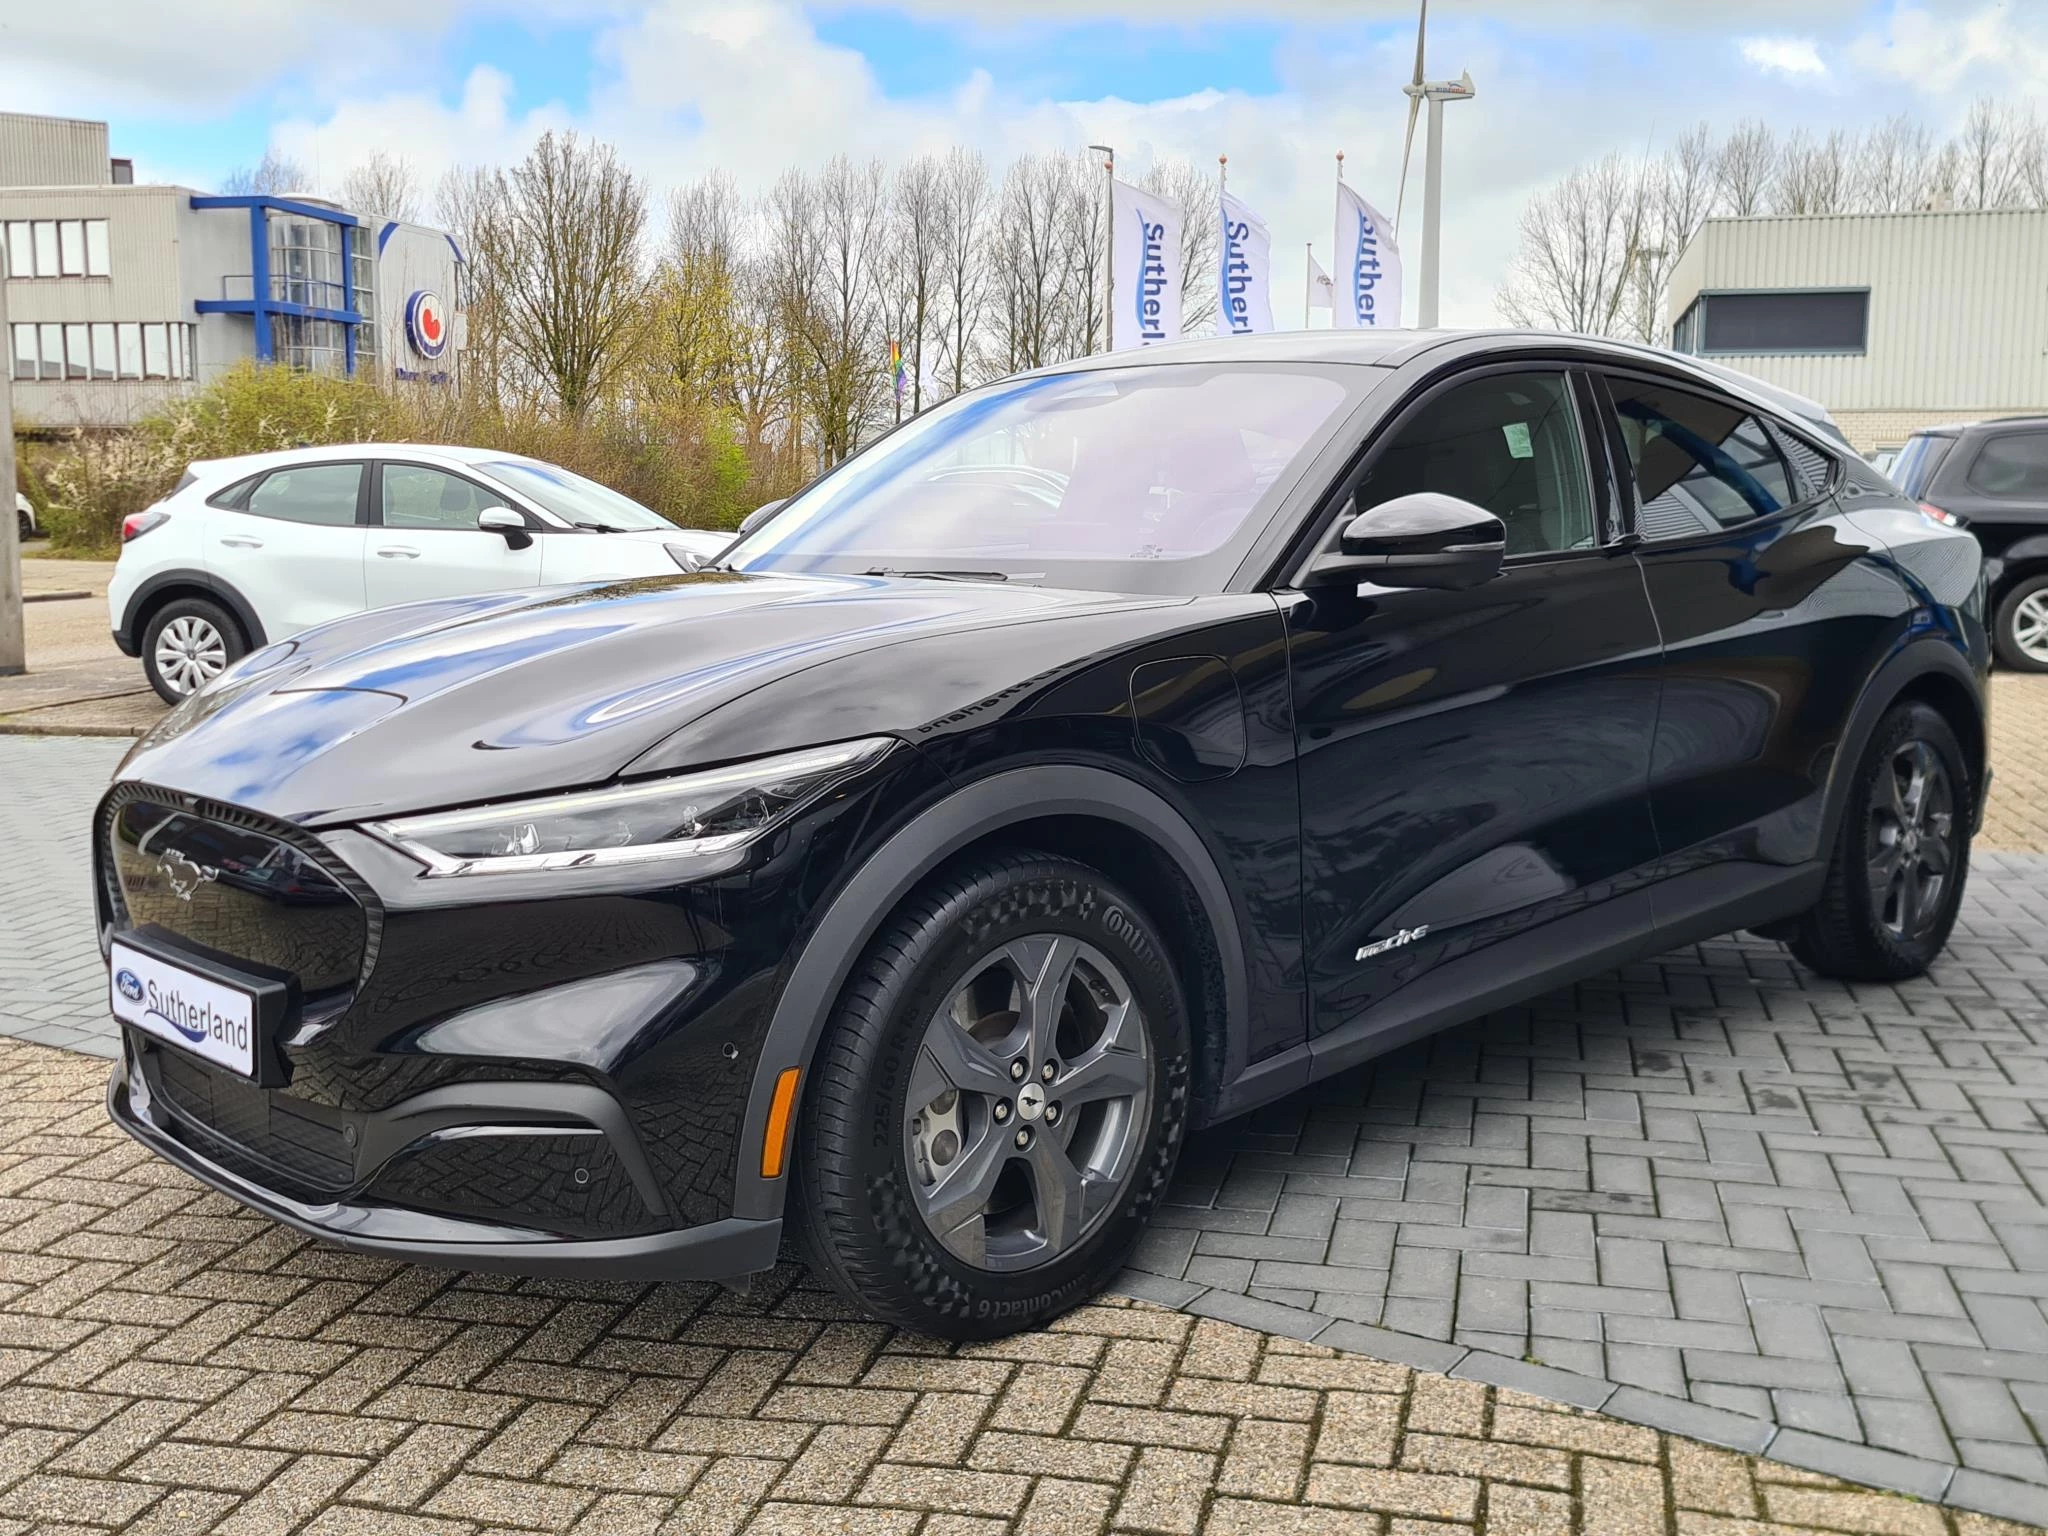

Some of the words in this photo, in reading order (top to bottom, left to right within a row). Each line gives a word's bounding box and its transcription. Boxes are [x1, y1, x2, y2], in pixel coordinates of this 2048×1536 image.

[1142, 222, 1168, 346] Sutherl
[1228, 221, 1253, 335] Sutherl
[147, 979, 248, 1052] Sutherland
